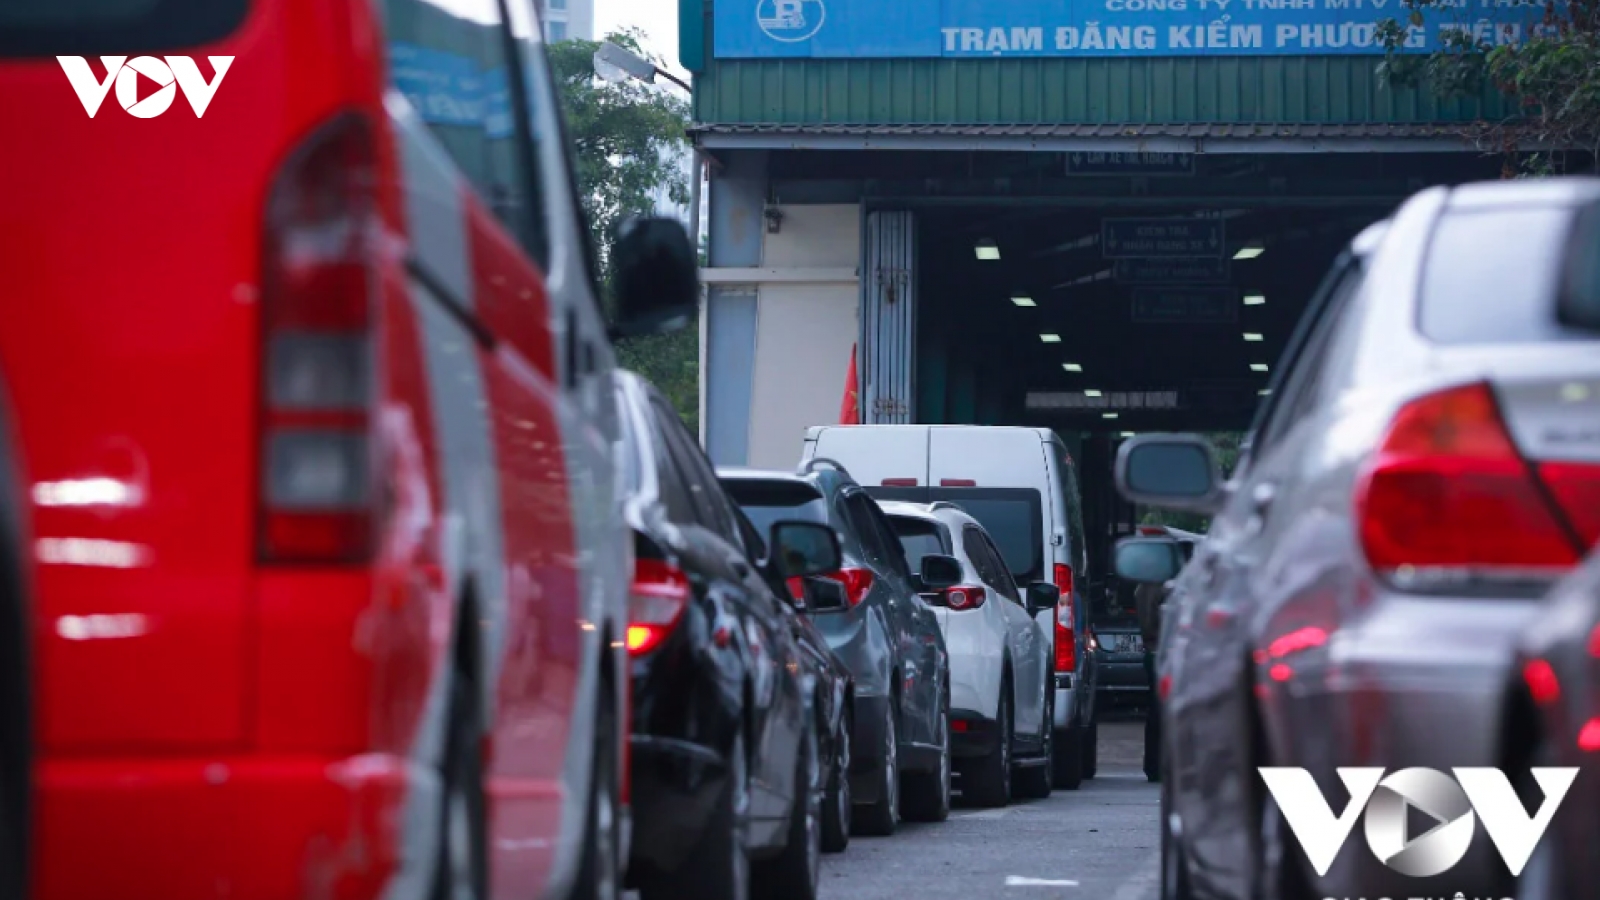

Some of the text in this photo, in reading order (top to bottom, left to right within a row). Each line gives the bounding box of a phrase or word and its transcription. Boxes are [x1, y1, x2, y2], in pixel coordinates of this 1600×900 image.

[941, 26, 1043, 55] TRẠM
[1054, 21, 1157, 50] ĐĂNG
[1168, 14, 1263, 48] KIỂM
